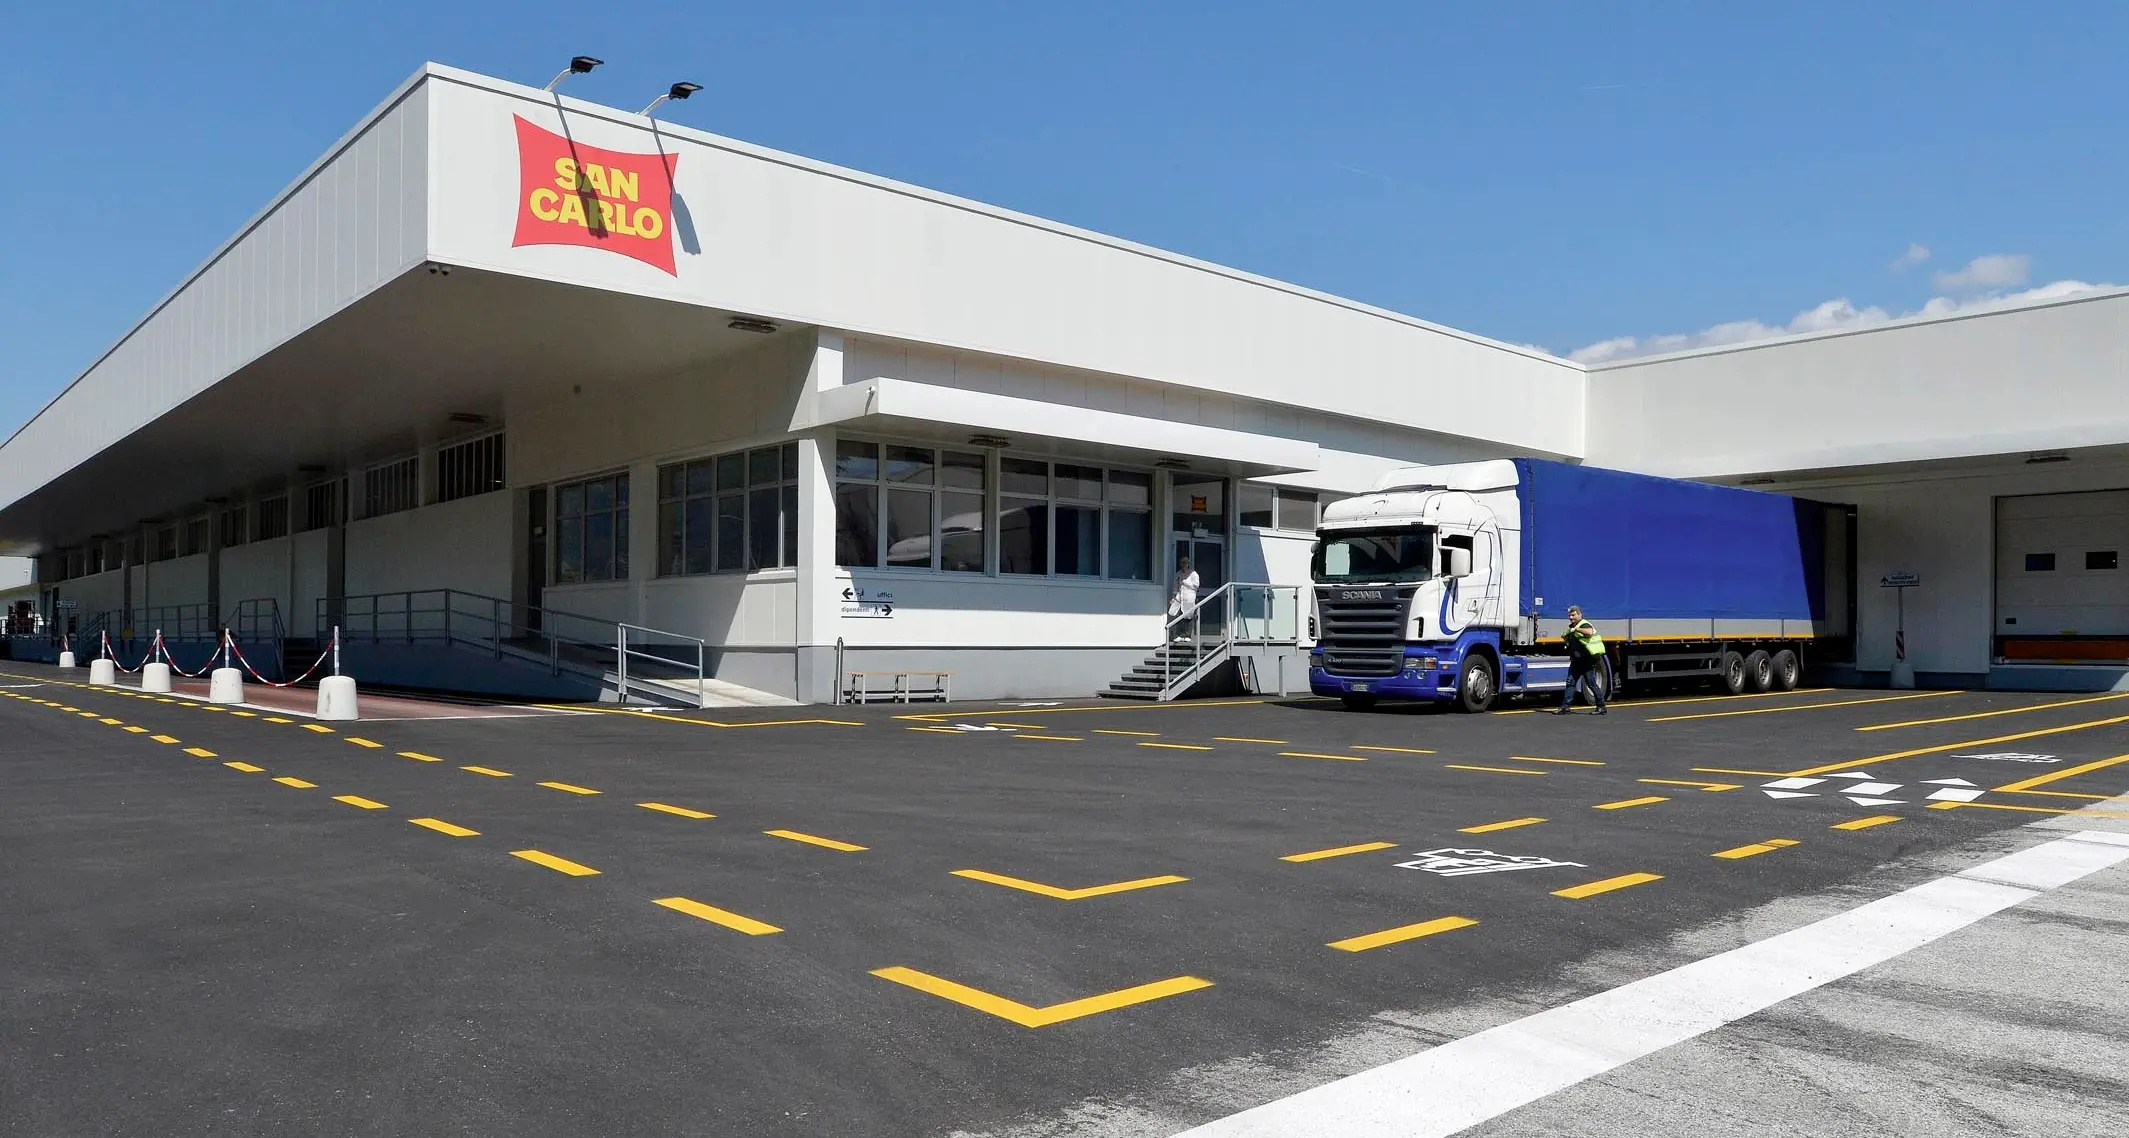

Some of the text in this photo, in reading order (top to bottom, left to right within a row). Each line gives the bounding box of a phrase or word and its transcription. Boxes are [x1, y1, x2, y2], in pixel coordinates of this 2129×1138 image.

[554, 157, 639, 203] SAN
[529, 187, 664, 240] CARLO
[1341, 590, 1383, 600] SCANIA
